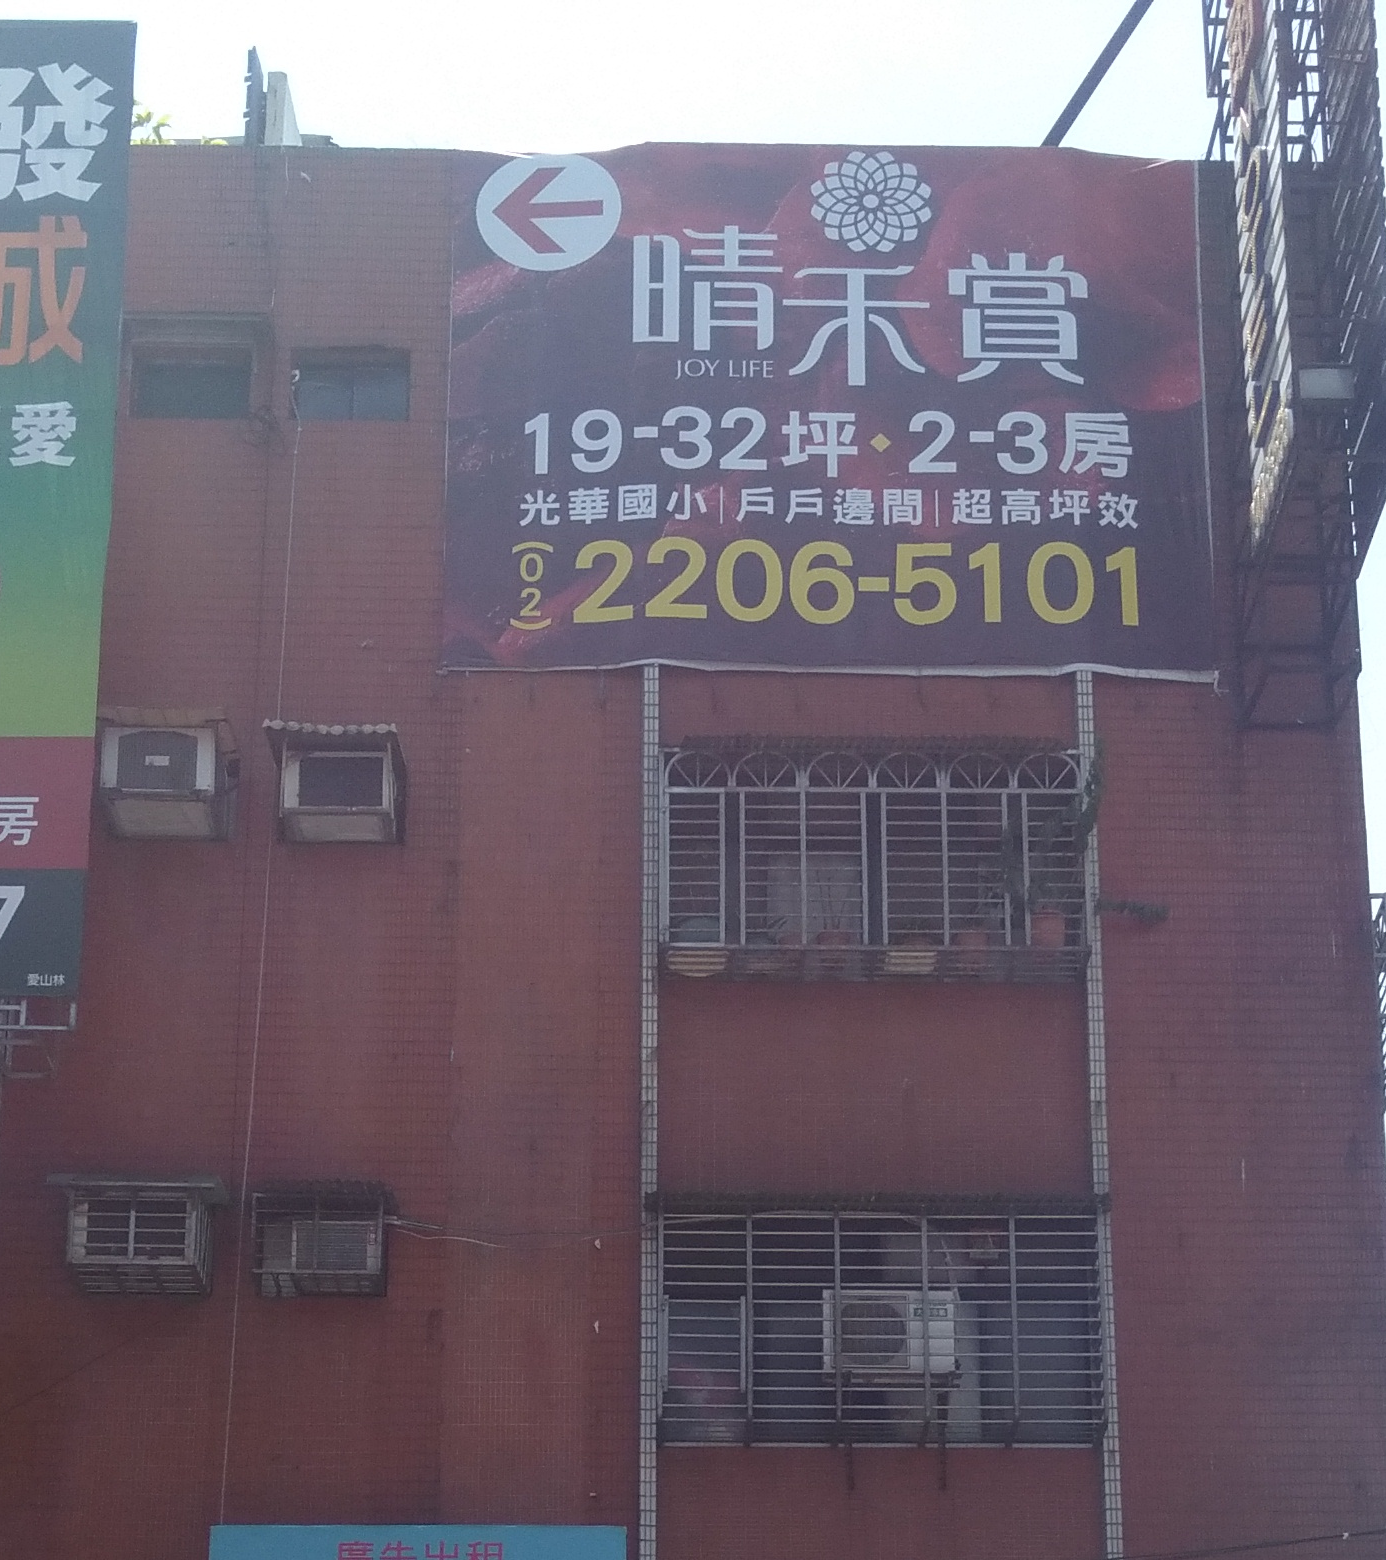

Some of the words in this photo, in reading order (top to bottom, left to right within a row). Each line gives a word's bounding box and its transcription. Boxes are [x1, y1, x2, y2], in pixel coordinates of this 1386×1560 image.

[631, 224, 1089, 386] 晴禾賞
[675, 358, 722, 380] JOY
[729, 359, 775, 380] LIFE
[519, 483, 708, 527] 光華國小
[951, 488, 1139, 531] 超高坪效
[572, 536, 1140, 627] 2206-5101
[26, 972, 66, 987] 愛山林
